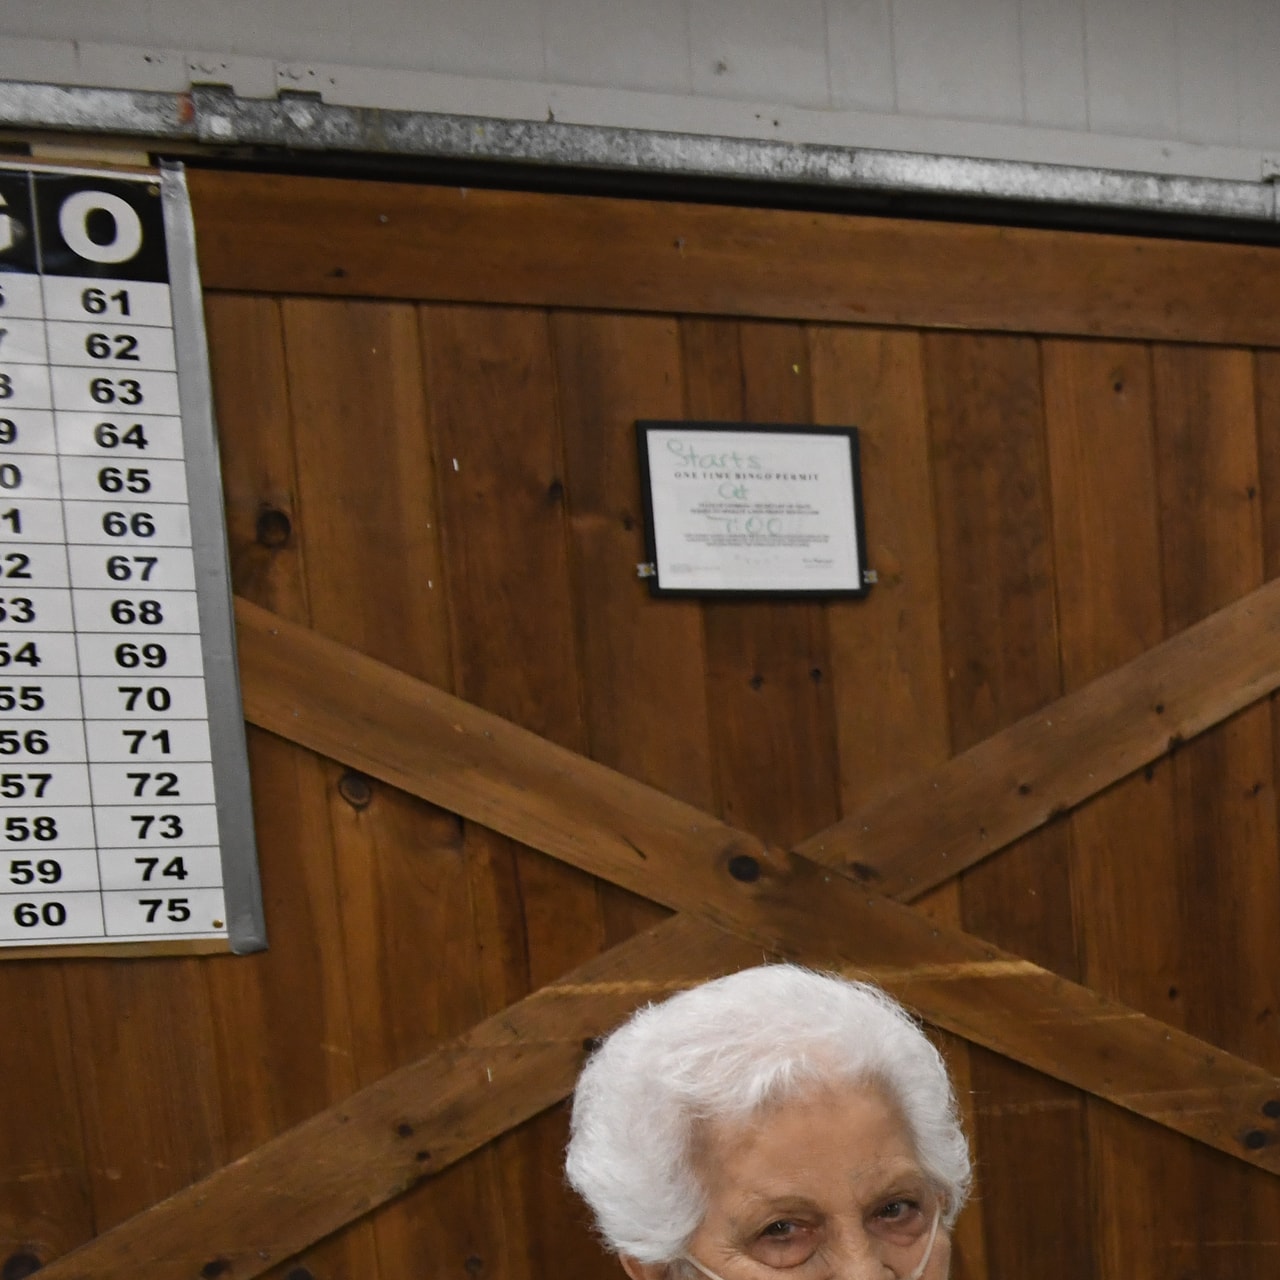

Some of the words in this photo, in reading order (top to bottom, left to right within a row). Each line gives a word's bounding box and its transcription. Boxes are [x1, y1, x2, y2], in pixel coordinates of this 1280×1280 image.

[60, 189, 143, 264] O
[82, 288, 131, 316] 61
[86, 333, 140, 361] 62
[0, 373, 13, 399] 8
[90, 378, 143, 405] 63
[0, 419, 17, 444] 9
[94, 424, 148, 450] 64
[0, 464, 21, 489] 0
[98, 468, 152, 493] 65
[2, 509, 21, 534] 1
[103, 512, 155, 537] 66
[0, 554, 31, 578] 2
[106, 556, 158, 581] 67
[111, 600, 163, 625] 68
[115, 643, 167, 668] 69
[0, 686, 44, 711] 55
[118, 686, 171, 711] 70
[0, 730, 49, 755] 56
[122, 730, 171, 754] 71
[1, 773, 52, 798] 57
[127, 773, 180, 797] 72
[6, 817, 58, 841] 58
[131, 815, 183, 839] 73
[10, 860, 62, 885] 59
[135, 857, 187, 881] 74
[14, 902, 66, 927] 60
[139, 899, 190, 923] 75
